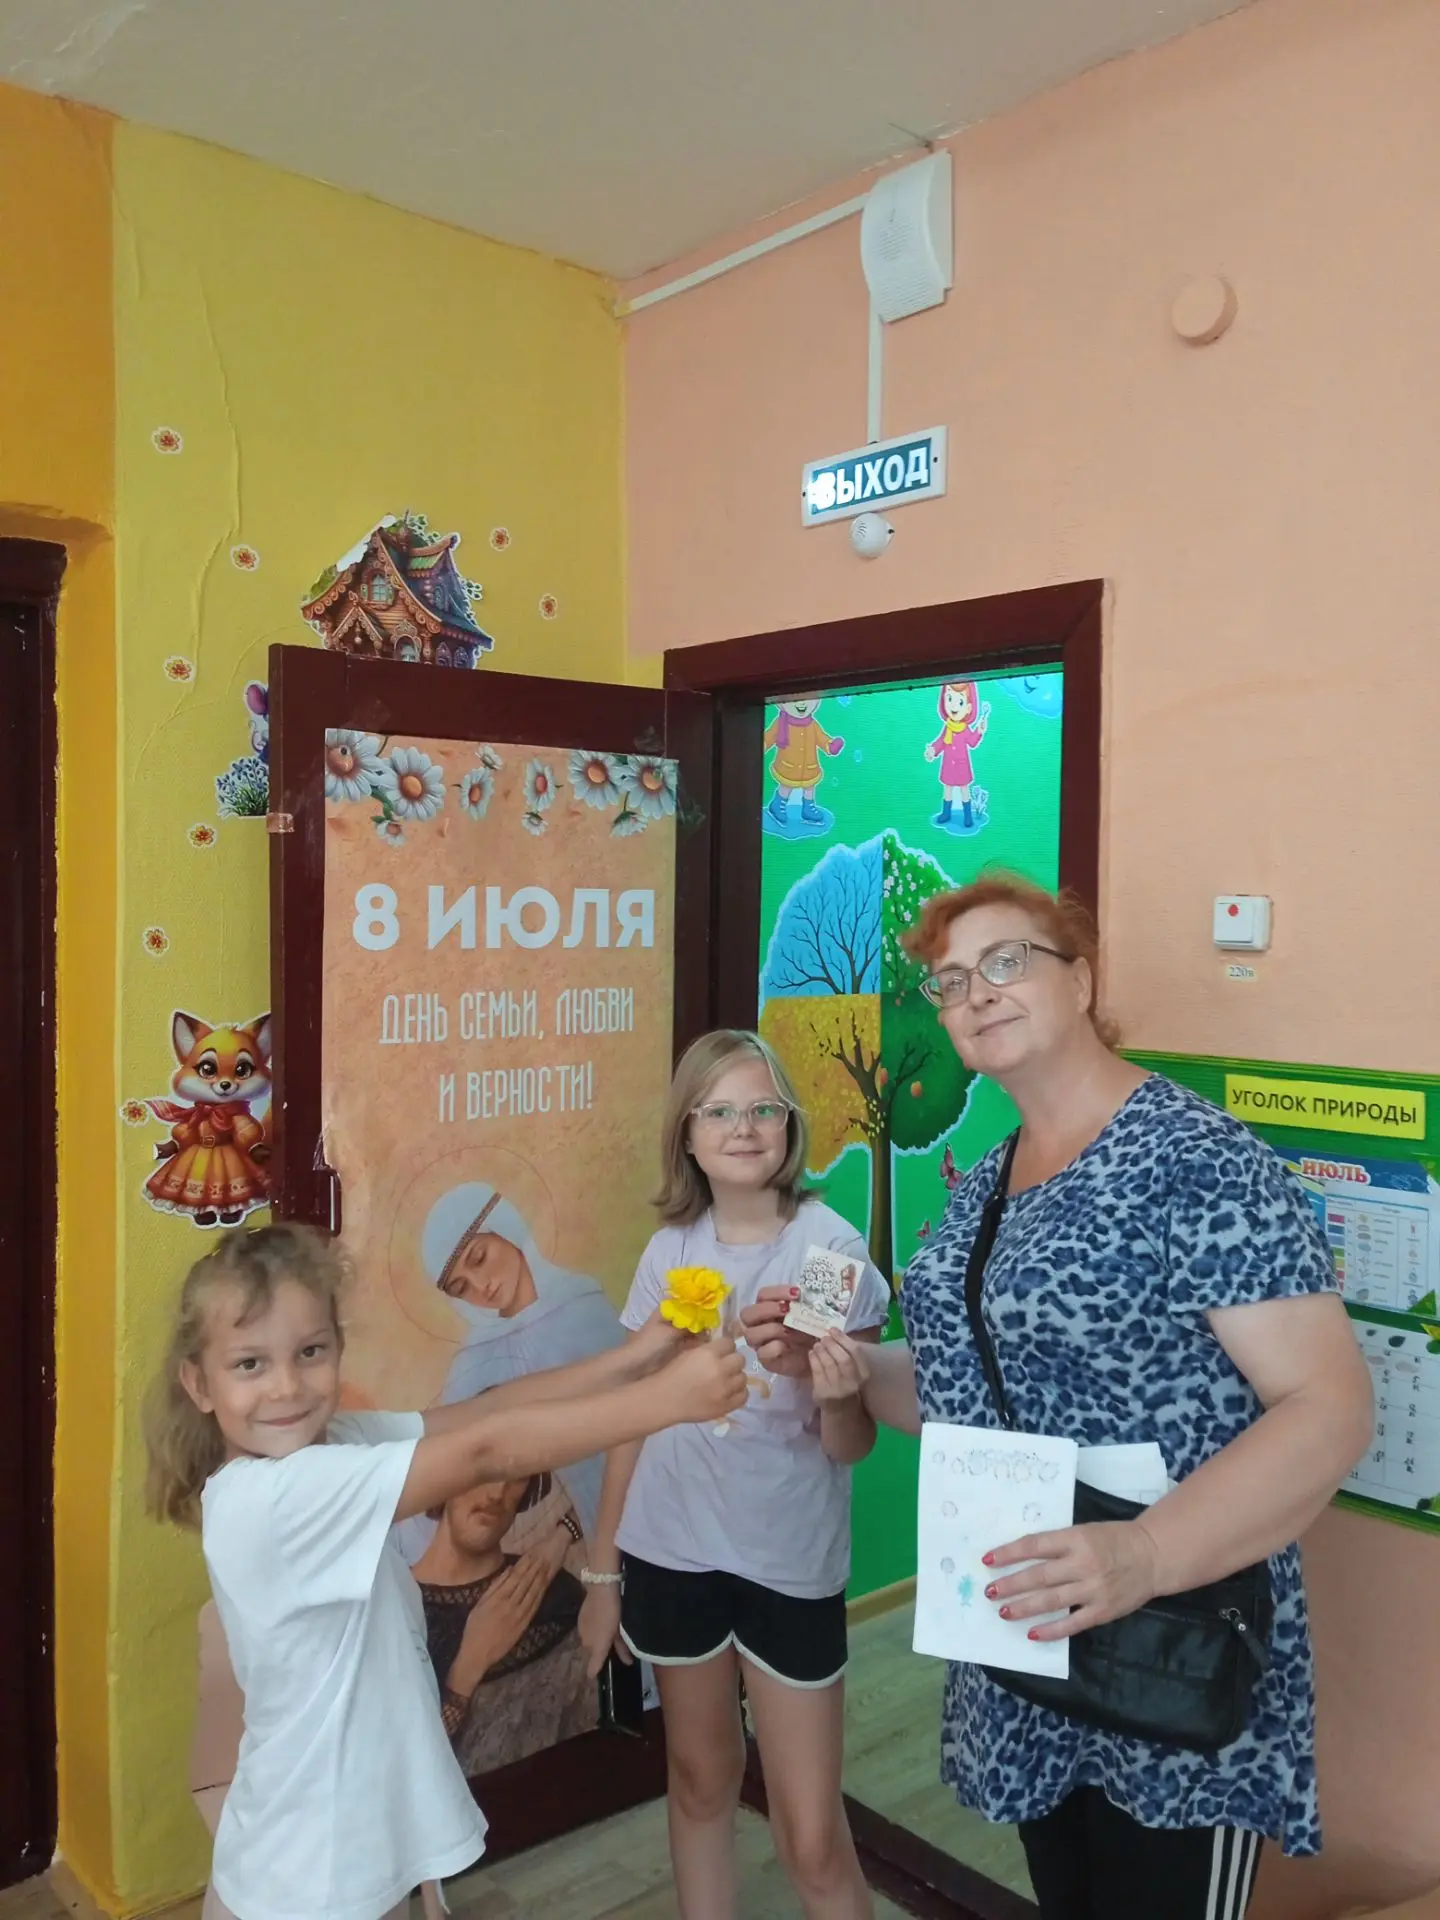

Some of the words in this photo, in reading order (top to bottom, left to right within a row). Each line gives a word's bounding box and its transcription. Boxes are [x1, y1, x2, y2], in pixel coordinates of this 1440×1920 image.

[809, 447, 929, 509] ВЫХОД
[352, 883, 399, 950] 8
[428, 885, 655, 949] ИЮЛЯ
[378, 993, 448, 1044] ДЕНЬ
[459, 989, 545, 1041] СЕМЬИ,
[555, 987, 635, 1036] ЛЮБВИ
[438, 1073, 455, 1123] И
[466, 1060, 593, 1120] ВЕРНОСТИ!
[1231, 1088, 1308, 1113] УГОЛОК
[1313, 1097, 1417, 1125] ПРИРОДЫ
